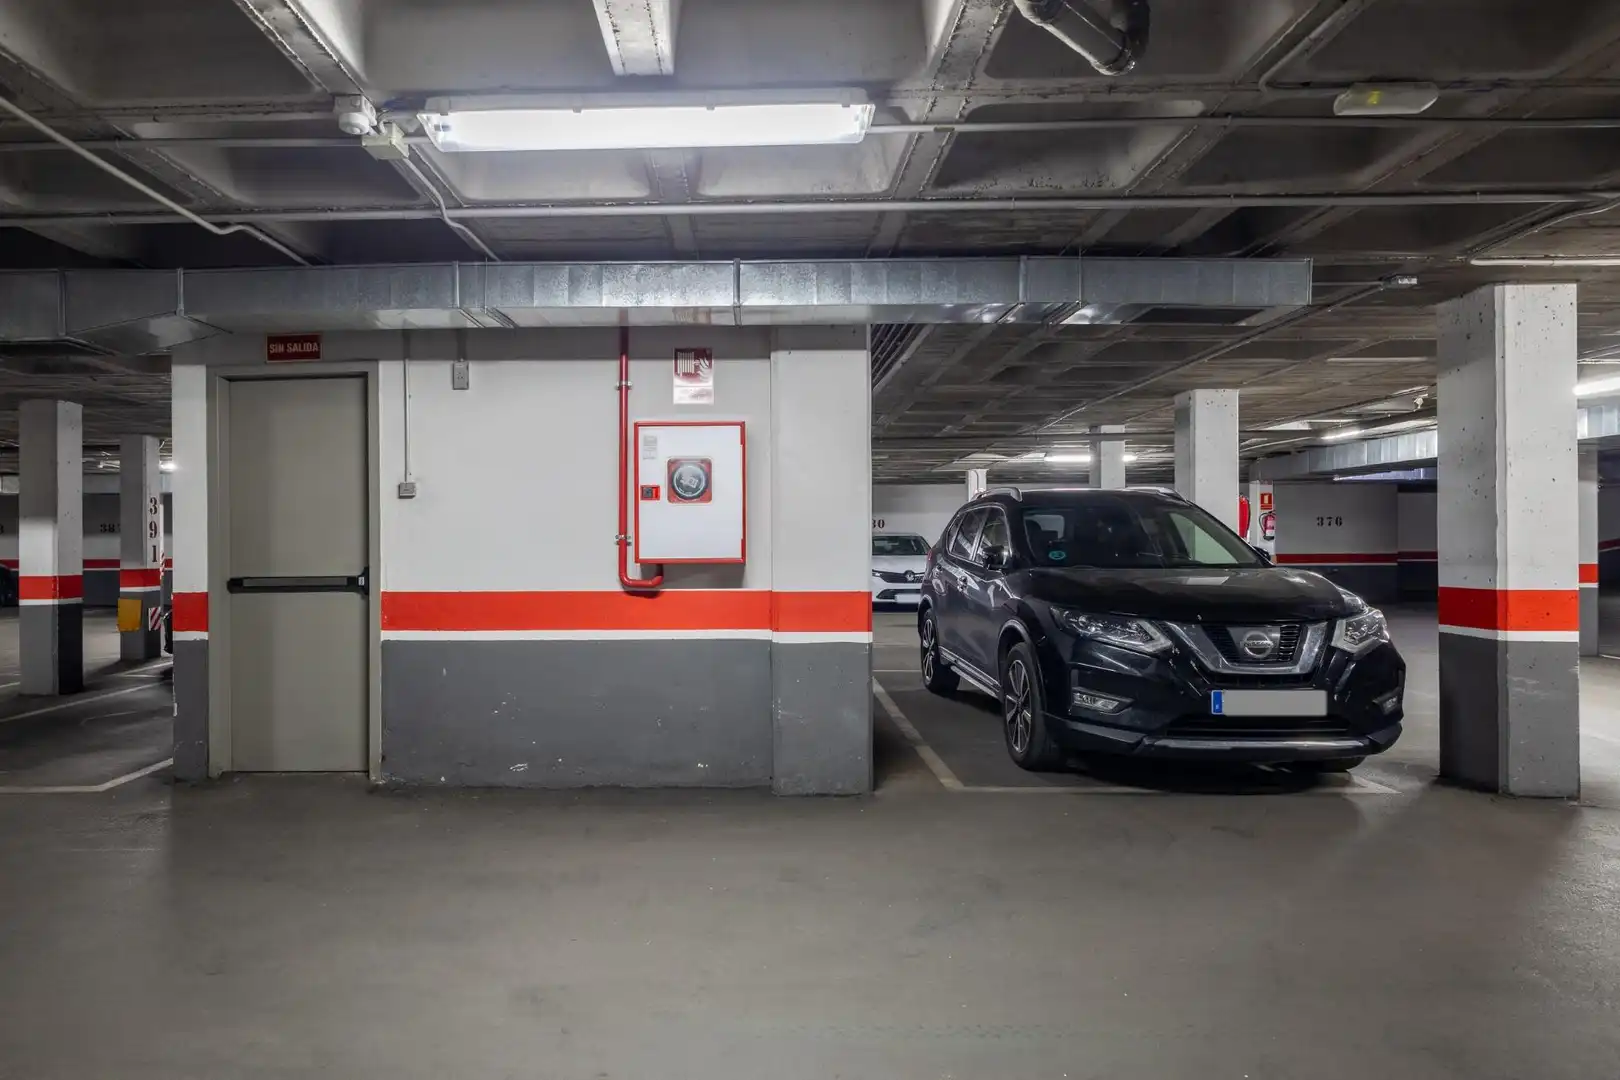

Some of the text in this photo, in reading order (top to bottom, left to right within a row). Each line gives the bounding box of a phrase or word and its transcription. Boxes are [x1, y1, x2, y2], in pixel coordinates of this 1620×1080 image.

[269, 341, 318, 354] SIN SALIDA
[1316, 516, 1343, 527] 376
[100, 523, 121, 533] 38
[148, 497, 158, 563] 391
